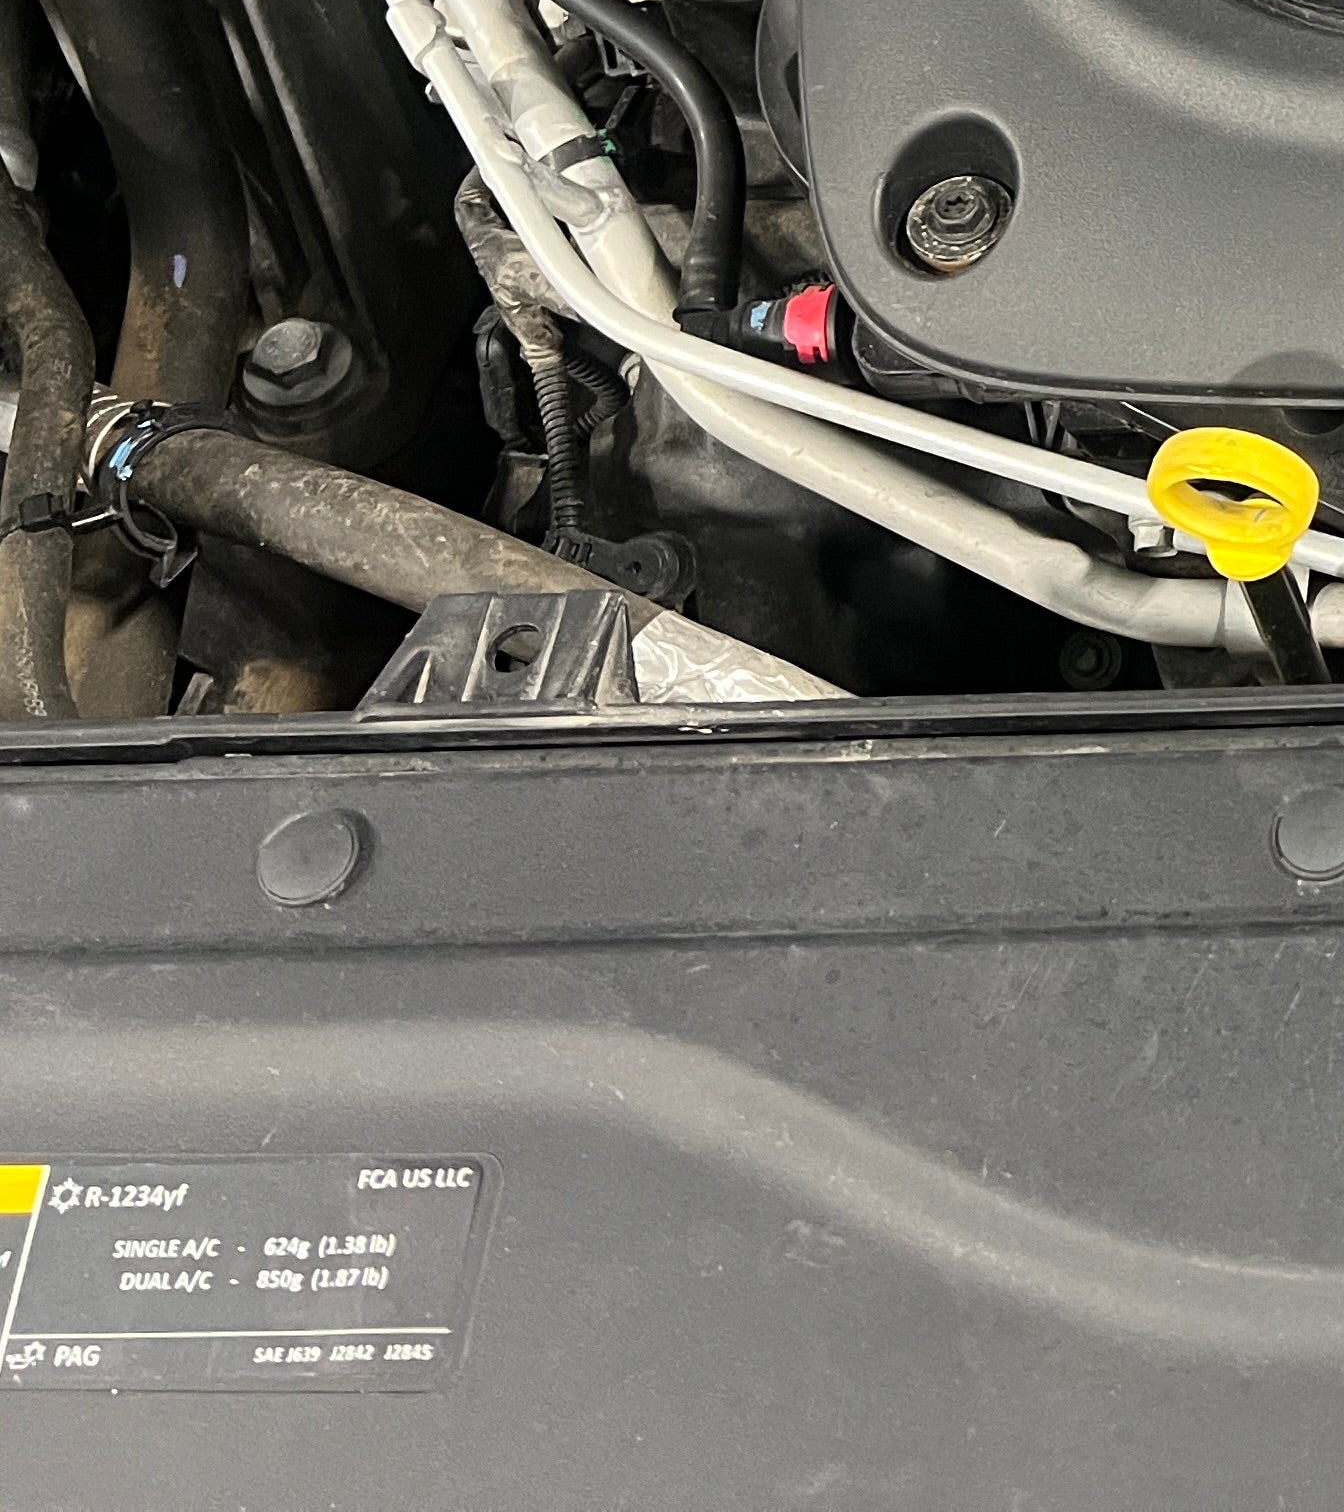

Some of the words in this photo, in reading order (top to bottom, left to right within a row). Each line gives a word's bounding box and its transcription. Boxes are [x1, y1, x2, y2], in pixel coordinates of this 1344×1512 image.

[357, 1168, 398, 1190] FCA
[402, 1168, 433, 1189] US
[434, 1166, 475, 1188] LLC
[84, 1183, 190, 1212] R-1234yf
[112, 1238, 180, 1260] SINGLE
[181, 1236, 221, 1261] A/C
[263, 1236, 312, 1260] 624g
[369, 1233, 397, 1257] lb)
[118, 1271, 172, 1291] DUAL
[173, 1269, 214, 1293] A/C
[255, 1269, 305, 1292] 850g
[310, 1267, 360, 1291] (1.87
[361, 1265, 390, 1290] lb)
[53, 1344, 102, 1368] PAG
[253, 1346, 285, 1364] SAE
